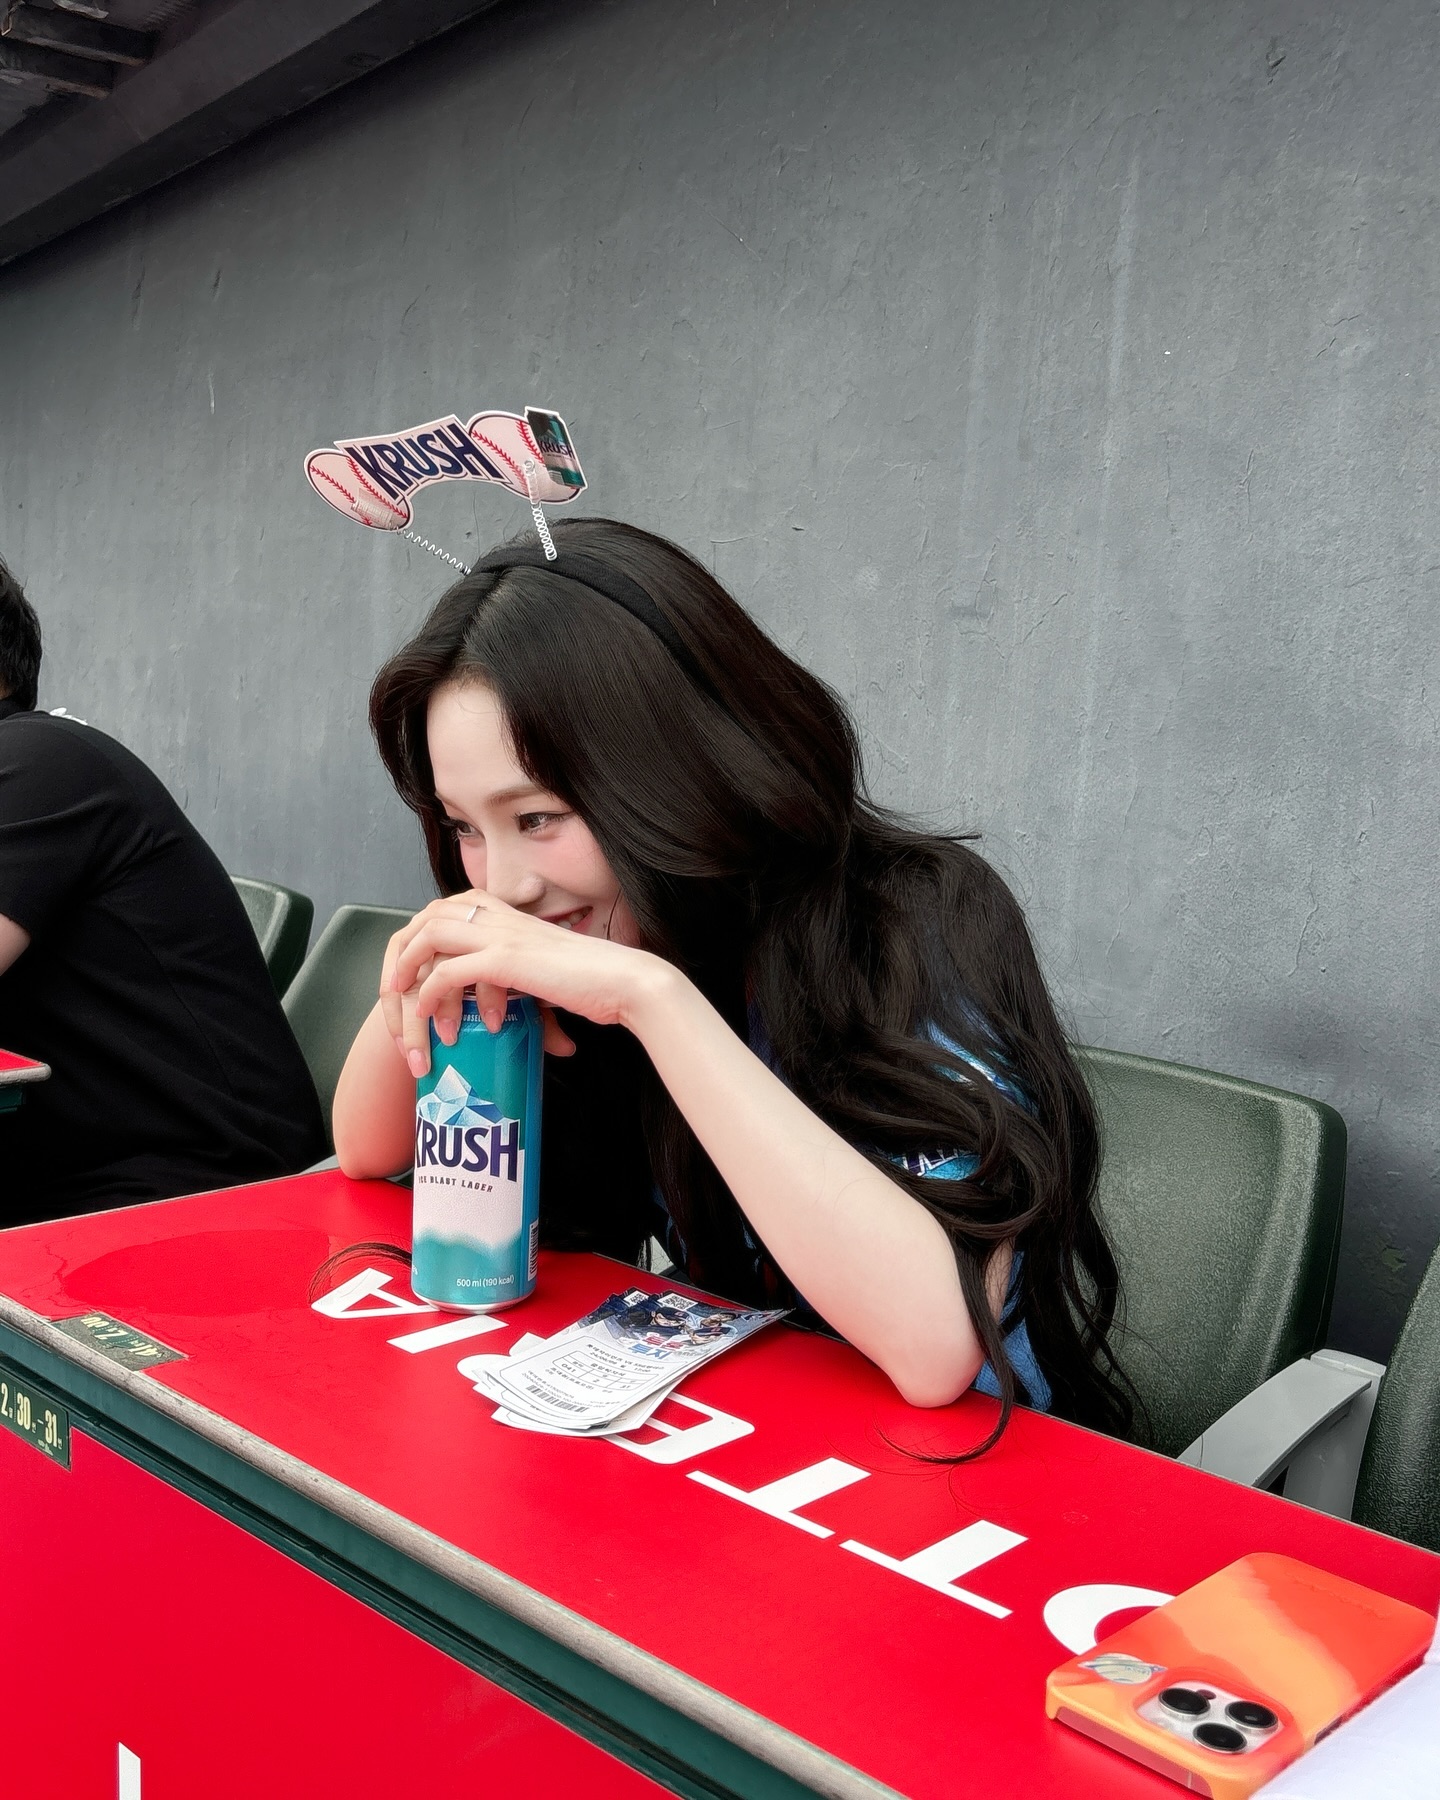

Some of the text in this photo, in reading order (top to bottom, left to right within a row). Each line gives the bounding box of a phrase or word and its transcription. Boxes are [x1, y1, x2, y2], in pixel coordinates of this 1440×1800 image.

[537, 439, 575, 459] KRUSH
[345, 423, 503, 499] KRUSH
[430, 1175, 457, 1186] BLAST
[461, 1179, 494, 1193] LAGER
[456, 1274, 516, 1288] 500 ml (190 kcal)
